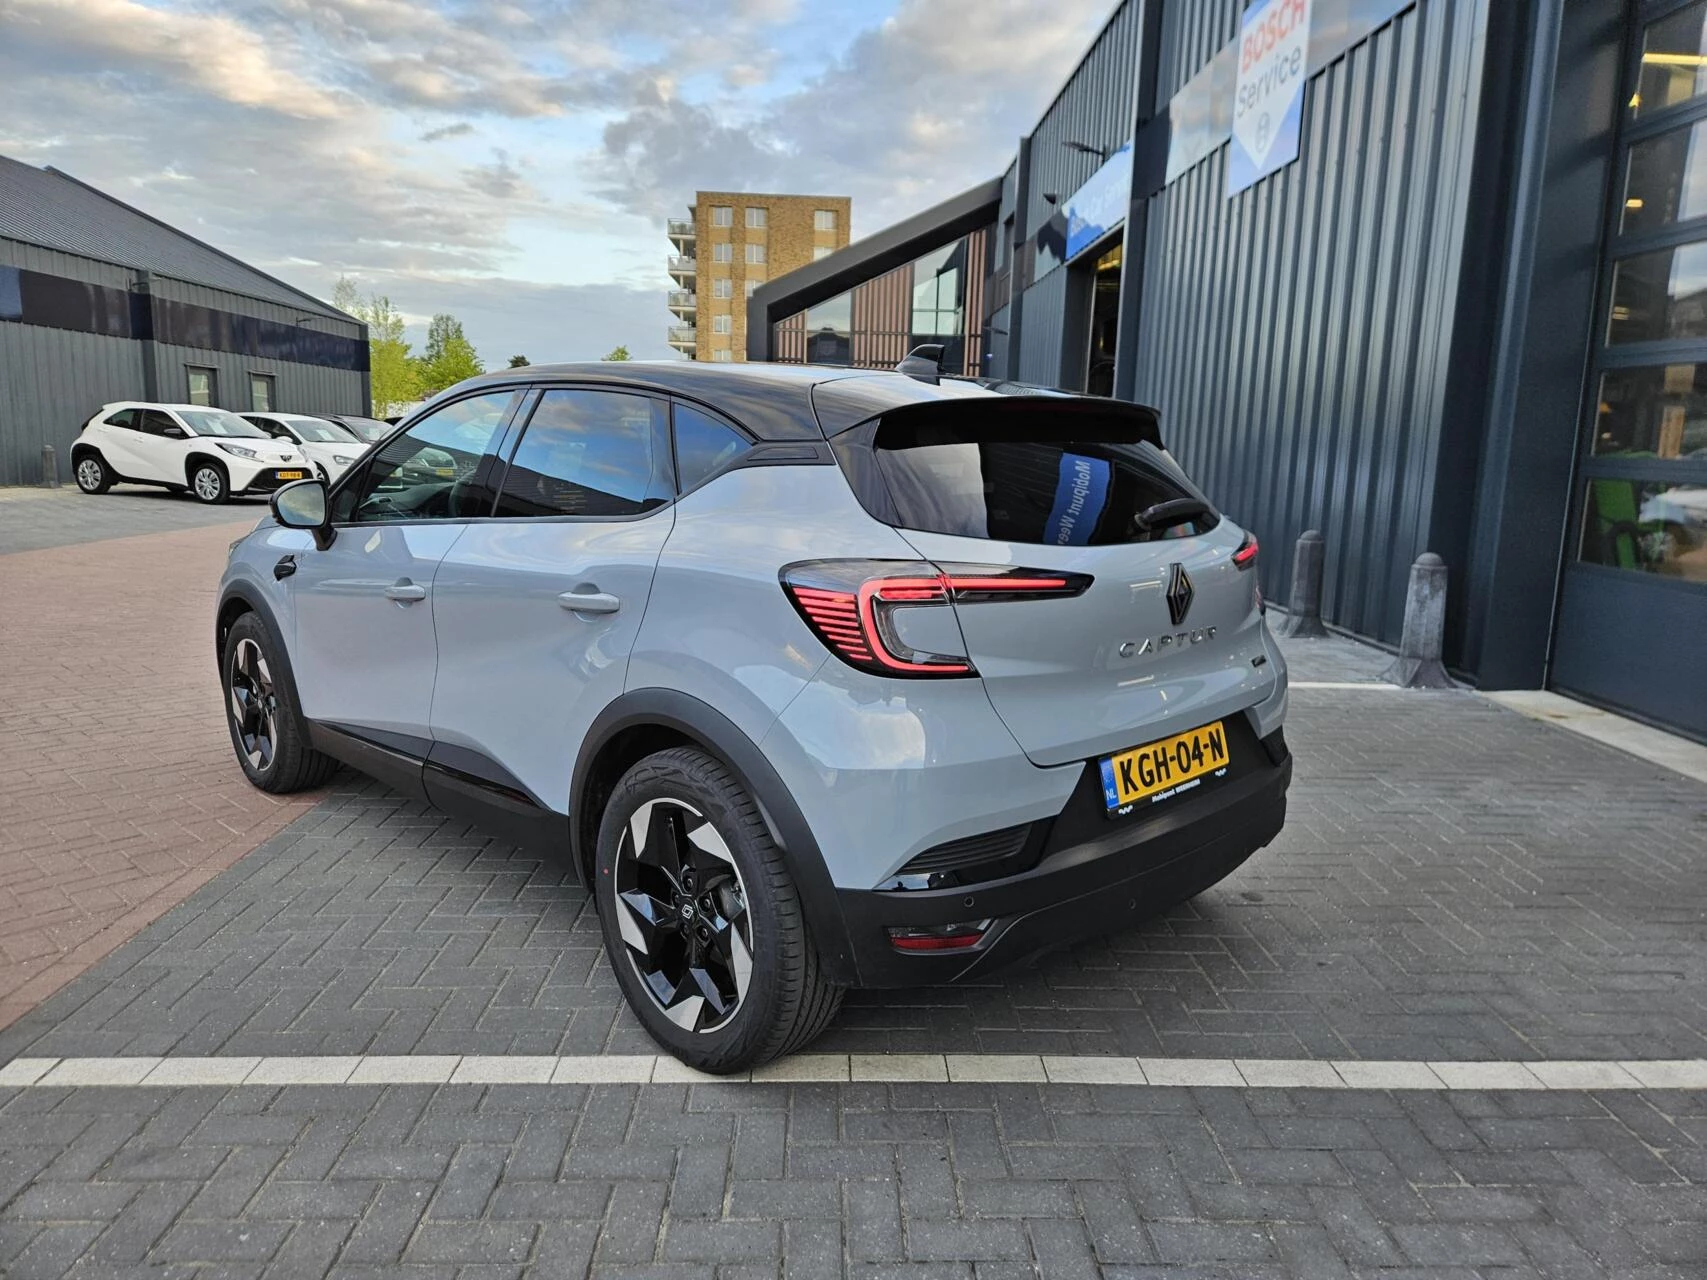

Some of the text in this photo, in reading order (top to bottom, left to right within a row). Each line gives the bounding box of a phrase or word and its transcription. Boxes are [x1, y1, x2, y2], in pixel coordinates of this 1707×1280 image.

[1242, 0, 1304, 73] BOSCH
[1237, 45, 1302, 118] Service
[1119, 626, 1217, 658] CAPTUR
[1105, 788, 1117, 800] NL
[1119, 728, 1225, 795] KGH-04-N
